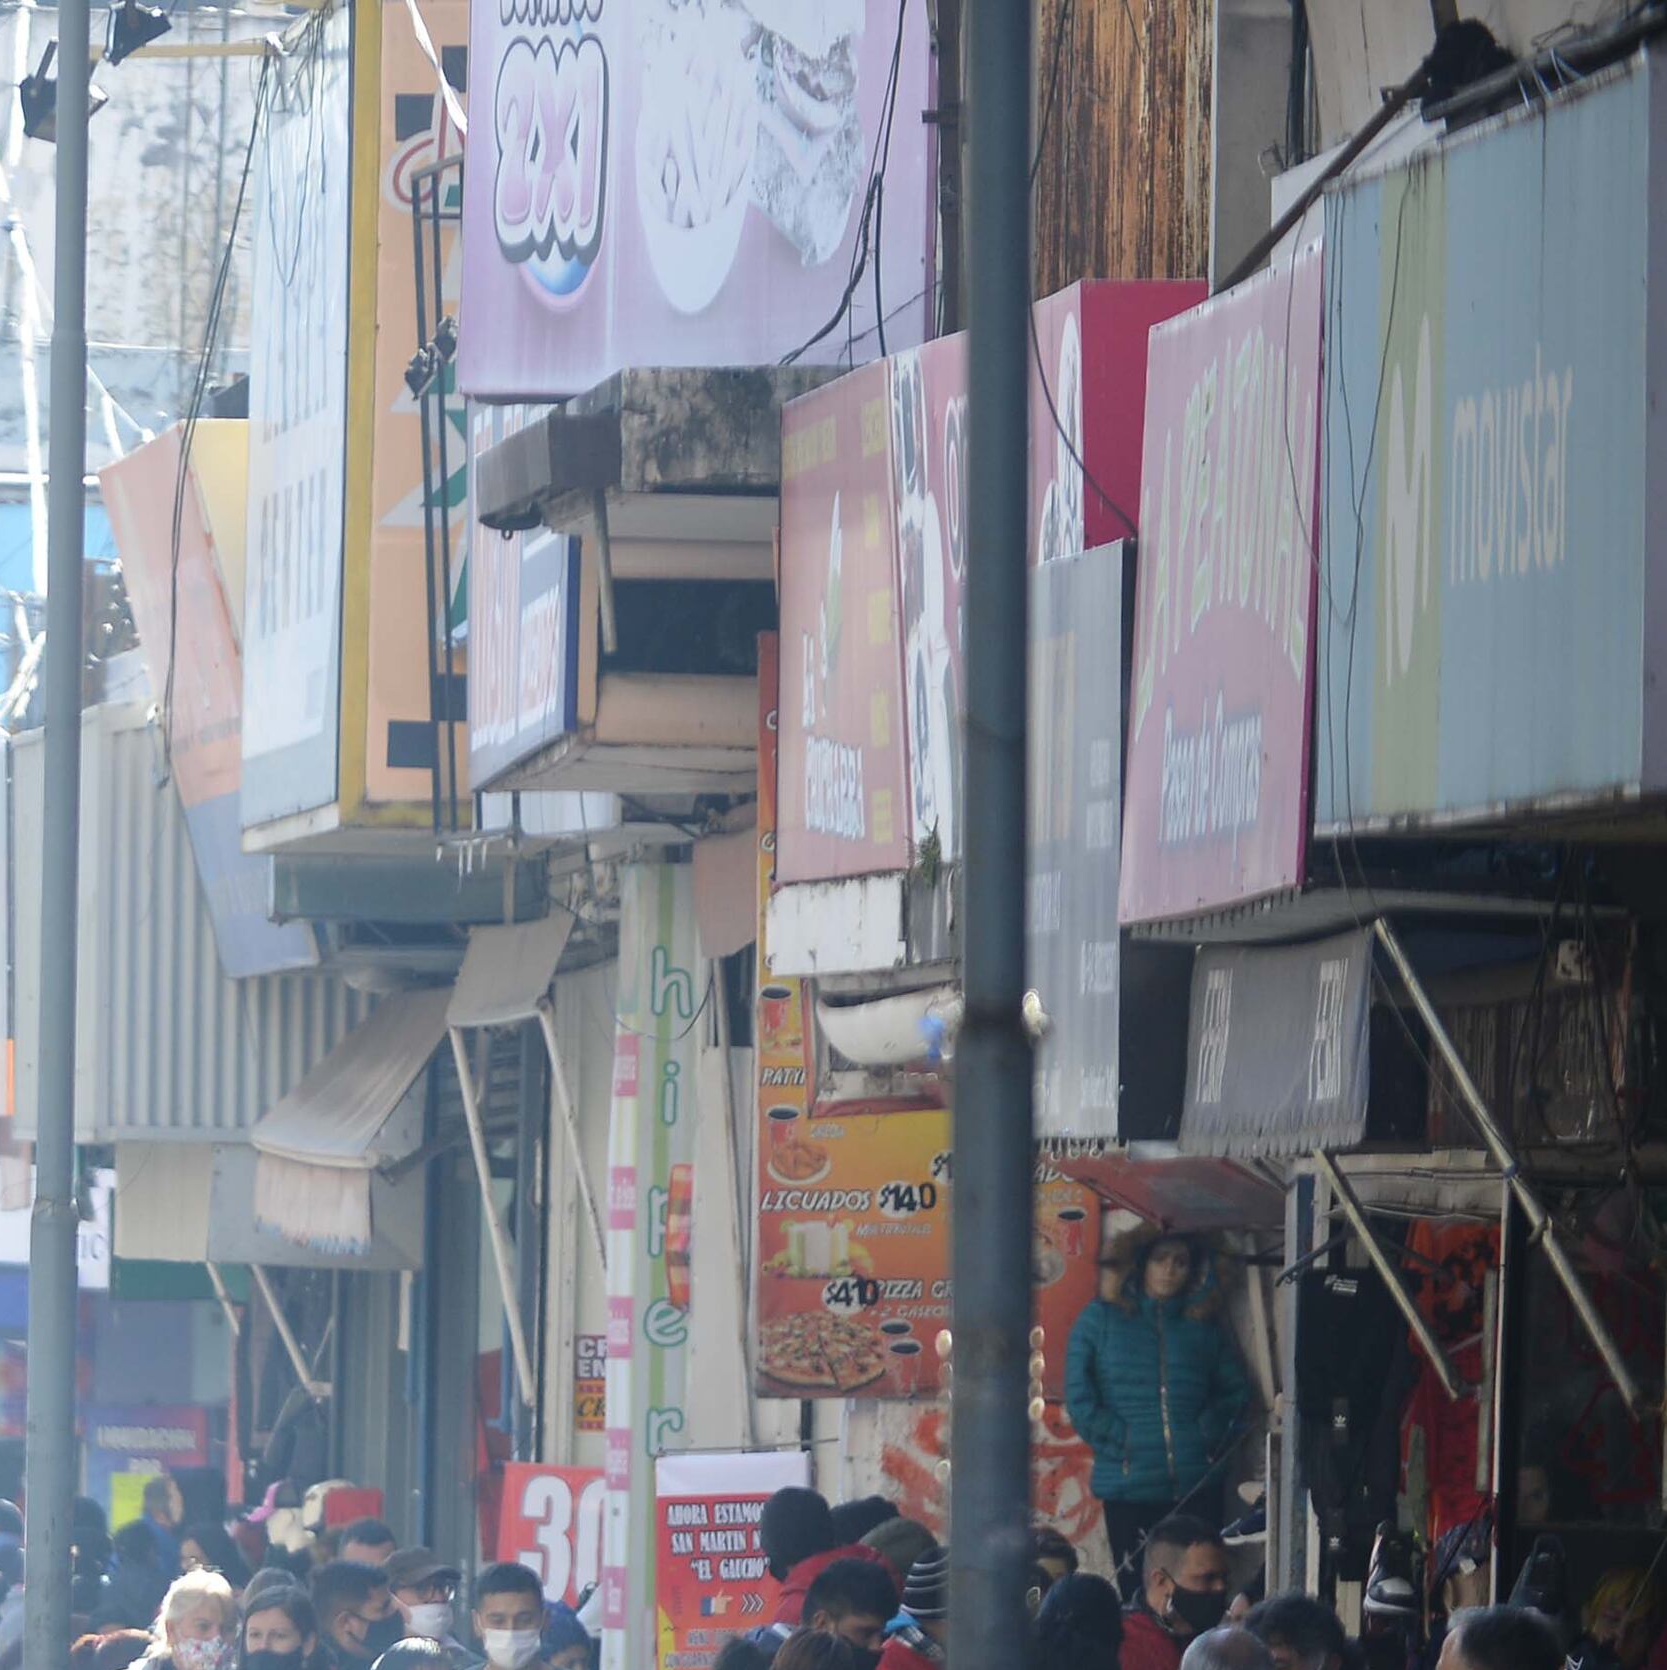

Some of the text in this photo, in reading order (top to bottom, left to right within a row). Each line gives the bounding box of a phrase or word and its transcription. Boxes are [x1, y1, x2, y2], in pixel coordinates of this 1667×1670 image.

[1450, 342, 1573, 587] movistar
[1135, 426, 1173, 745] LA
[1174, 325, 1314, 684] PEATONAL
[1158, 689, 1263, 860] Paseo de Compras
[760, 1181, 937, 1213] LICUADOS $140
[667, 1501, 766, 1527] AHORA ESTAMO
[671, 1531, 694, 1555] SAN
[700, 1530, 748, 1555] MARTIN
